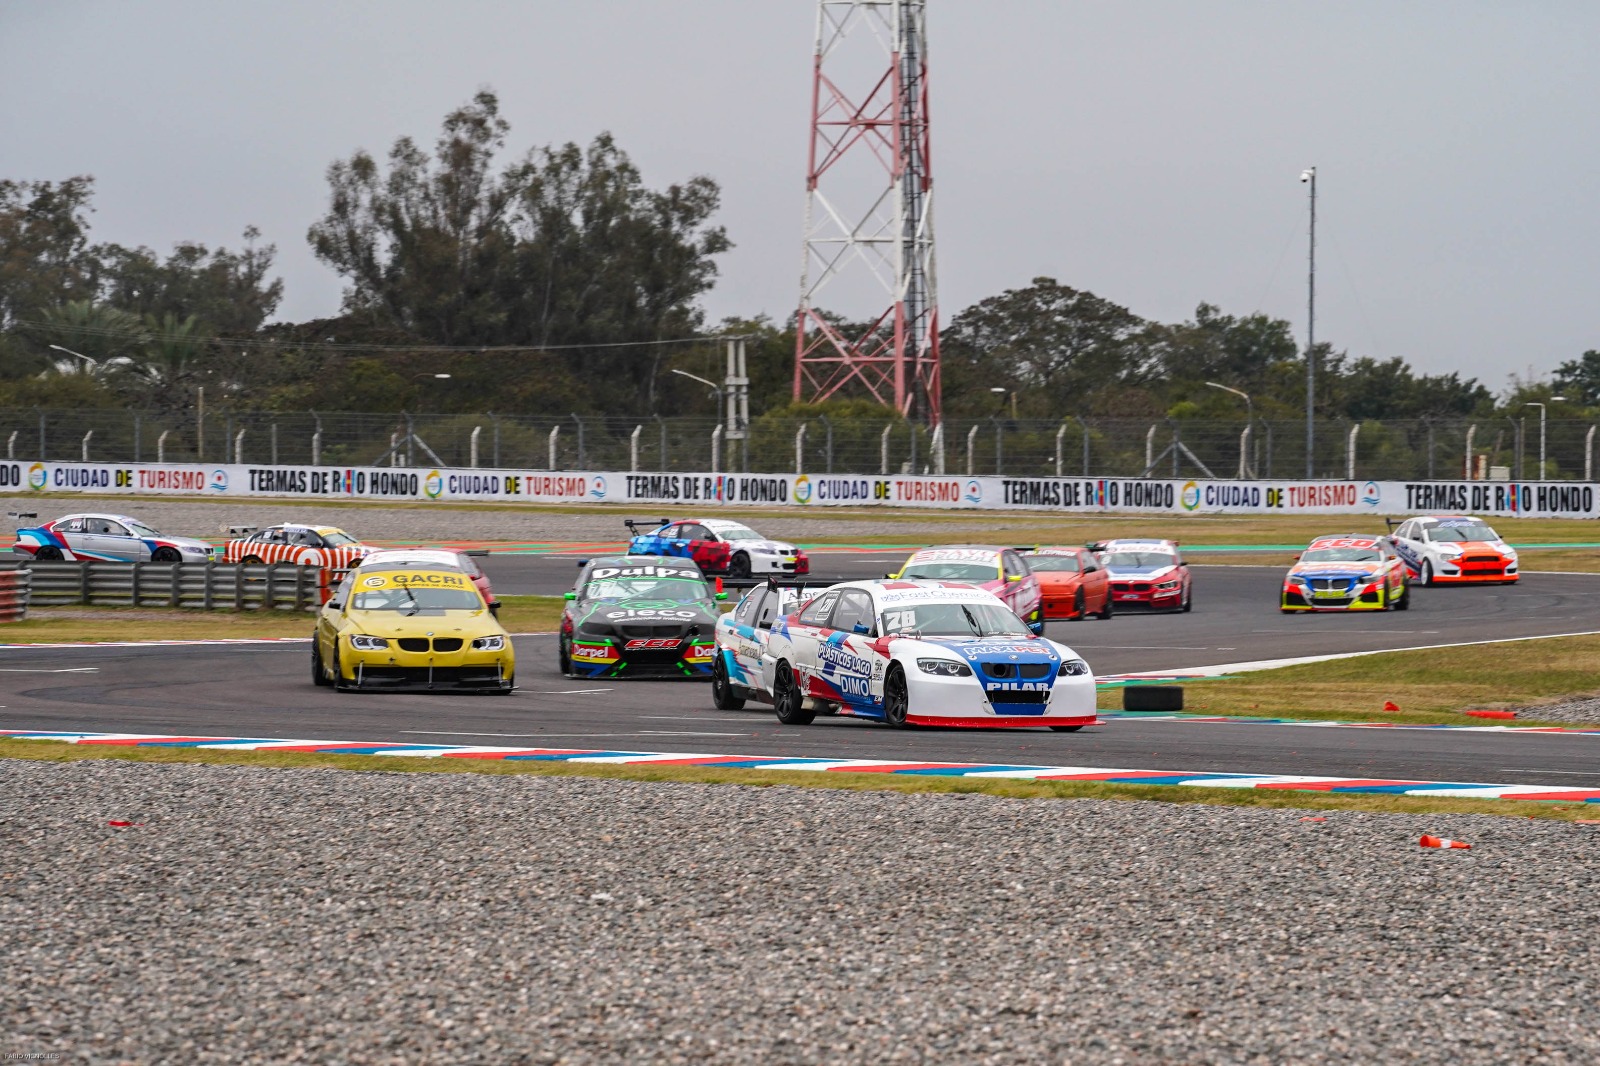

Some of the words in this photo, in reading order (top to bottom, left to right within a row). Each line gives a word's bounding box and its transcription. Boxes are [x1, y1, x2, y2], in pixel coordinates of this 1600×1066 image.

[54, 468, 109, 488] CIUDAD
[115, 469, 133, 488] DE
[138, 470, 205, 490] TURISMO
[249, 469, 306, 493] TERMAS
[311, 471, 328, 494] DE
[370, 471, 417, 496] HONDO
[448, 475, 499, 495] CIUDAD
[505, 476, 521, 495] DE
[525, 476, 585, 497] TURISMO
[626, 475, 679, 499] TERMAS
[683, 477, 699, 500] DE
[740, 478, 787, 502] HONDO
[818, 479, 869, 500] CIUDAD
[874, 480, 890, 501] DE
[896, 480, 960, 502] TURISMO
[1003, 480, 1060, 506] TERMAS
[1063, 482, 1080, 507] DE
[1124, 483, 1174, 509] HONDO
[1205, 484, 1260, 507] CIUDAD
[1266, 486, 1284, 508] DE
[1288, 484, 1356, 507] TURISMO
[1405, 484, 1466, 511] TERMAS
[1471, 485, 1490, 512] DE
[1537, 485, 1592, 513] HONDO
[392, 575, 463, 585] GACRI
[592, 566, 699, 579] Dulpa
[606, 609, 697, 619] eleco
[885, 610, 916, 631] 28
[573, 644, 609, 659] Darpel
[963, 646, 1052, 656] MAXIPET
[852, 657, 872, 676] LAGO
[841, 676, 869, 697] DIMO
[986, 682, 1049, 691] PILAR
